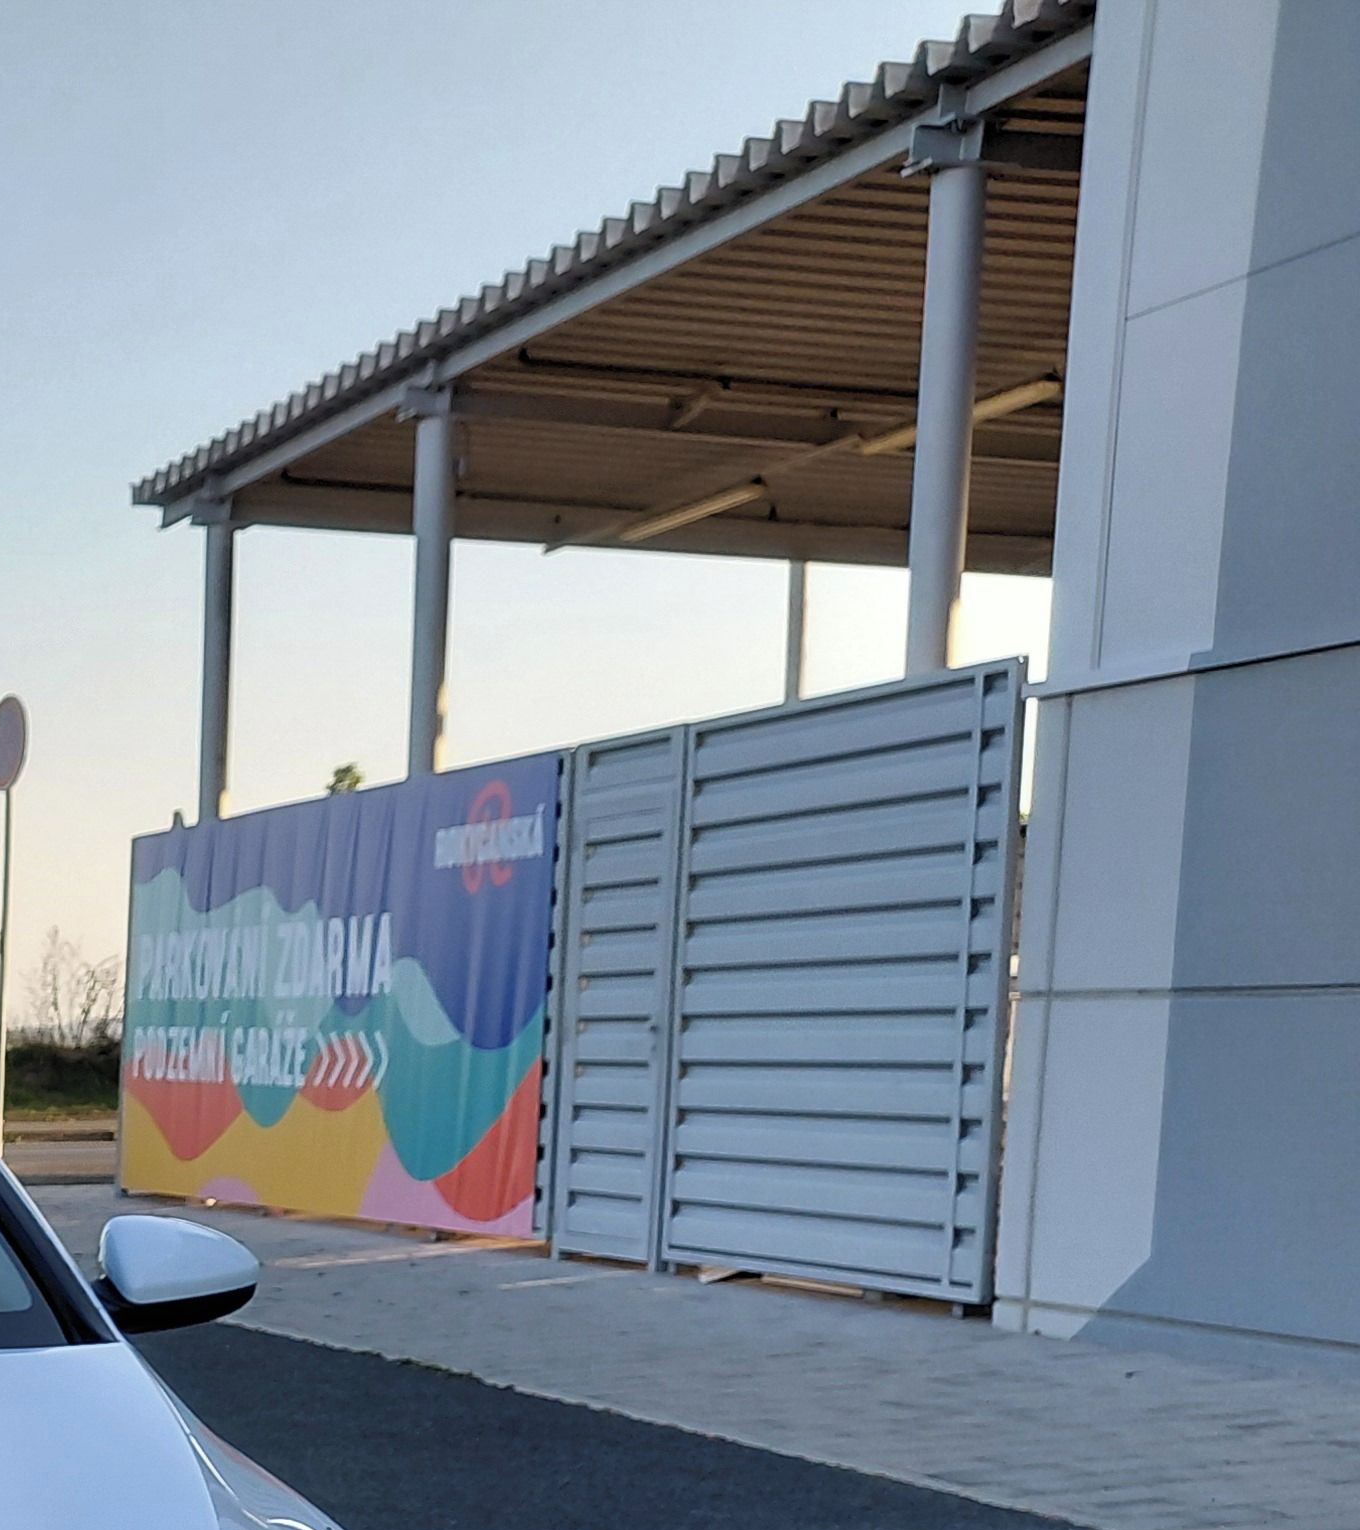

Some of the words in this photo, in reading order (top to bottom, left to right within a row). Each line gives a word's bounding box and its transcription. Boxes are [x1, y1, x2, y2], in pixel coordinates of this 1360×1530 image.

[275, 912, 393, 996] ZDARMA
[132, 1010, 231, 1082] PODZEMNÍ
[230, 1012, 308, 1086] GARÁŽE
